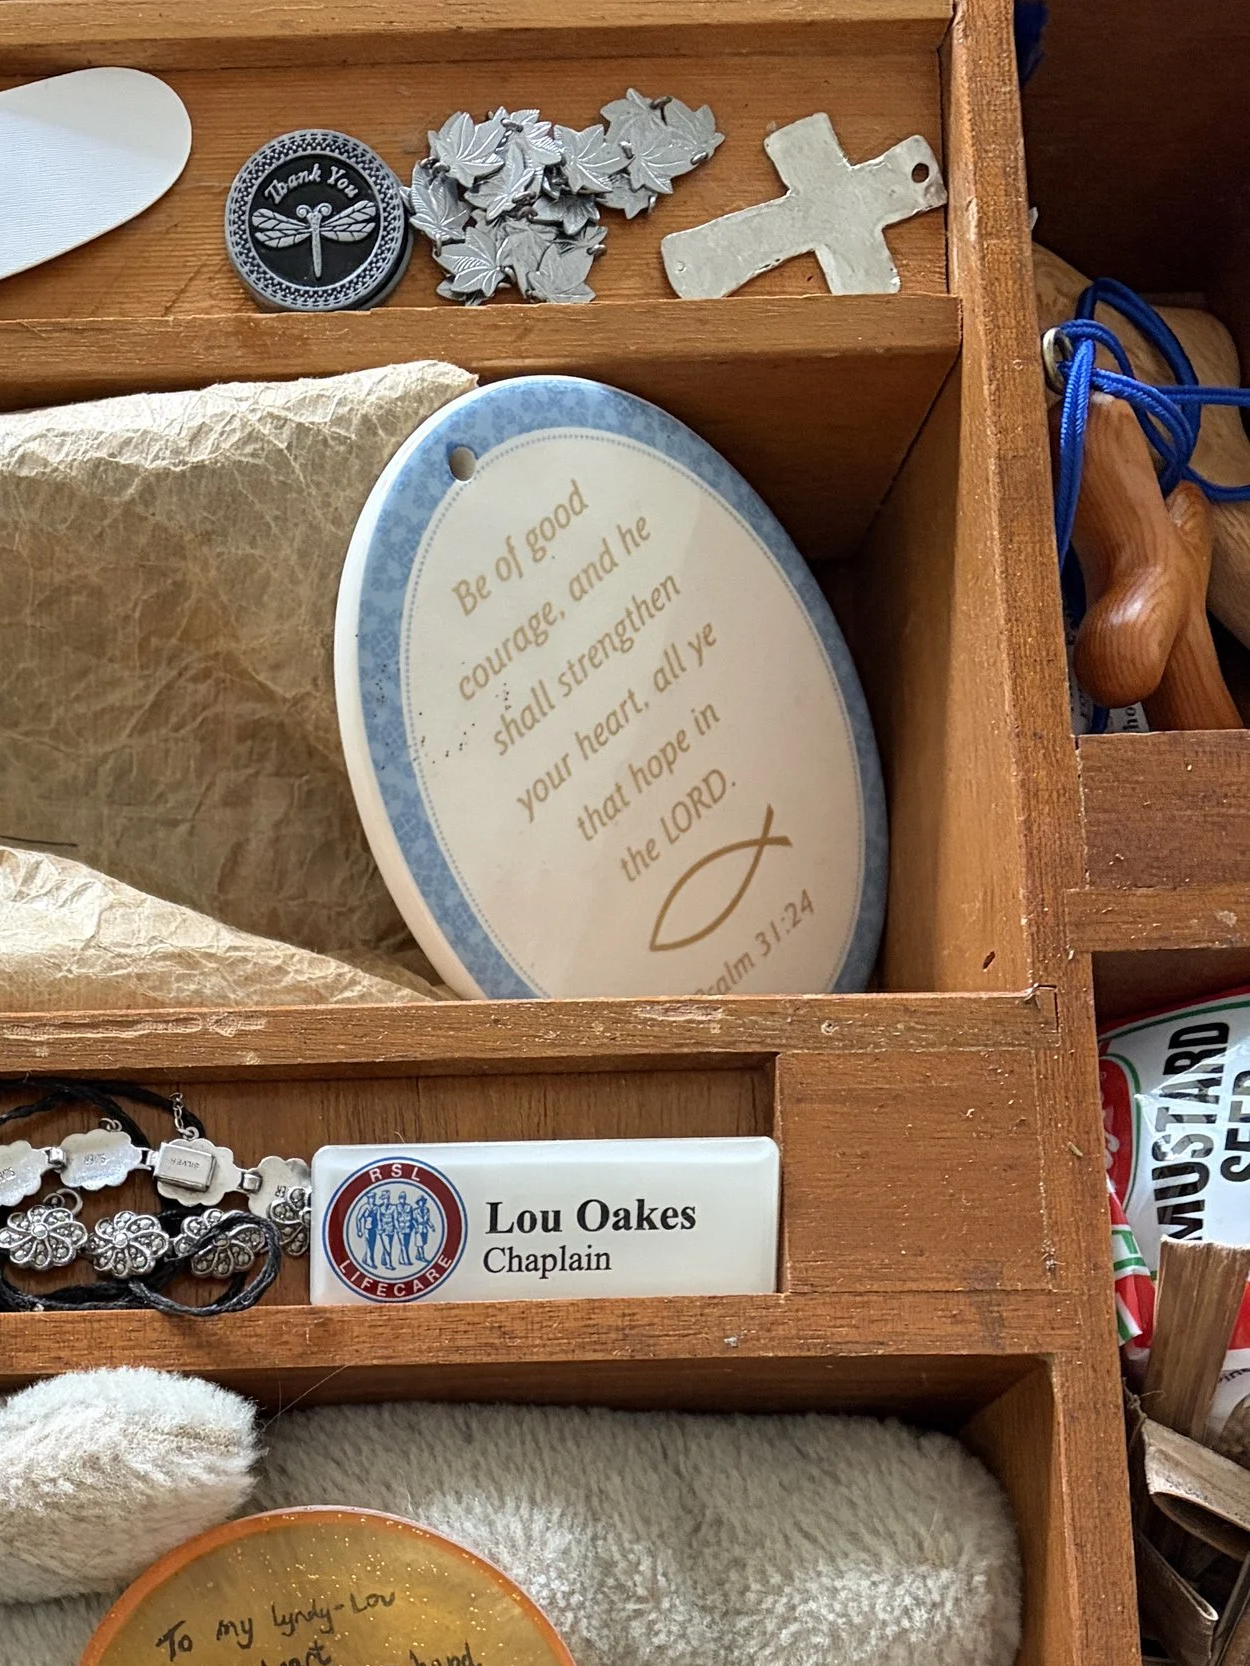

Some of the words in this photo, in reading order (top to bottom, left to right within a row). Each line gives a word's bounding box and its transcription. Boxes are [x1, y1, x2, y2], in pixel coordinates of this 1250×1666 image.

[264, 163, 321, 204] Thank
[327, 166, 358, 198] You
[450, 578, 492, 617] Be
[494, 536, 523, 585] of
[524, 479, 589, 563] good
[457, 601, 566, 702] courage,
[568, 538, 619, 603] and
[616, 513, 652, 558] he
[492, 679, 557, 756] shall
[557, 573, 682, 698] strengthen
[515, 754, 574, 823] your
[651, 643, 688, 695] all
[688, 622, 719, 669] ye
[577, 791, 631, 842] that
[631, 728, 691, 794] hope
[691, 700, 721, 738] in
[620, 840, 661, 883] the
[660, 766, 737, 845] LORD.
[755, 888, 814, 956] 31:24
[368, 1164, 421, 1183] RSL
[485, 1200, 562, 1235] Lou
[576, 1198, 696, 1232] Oakes
[338, 1252, 452, 1297] LIFECARE
[483, 1244, 612, 1279] Chaplain
[156, 1620, 193, 1662] To
[216, 1617, 253, 1649] my
